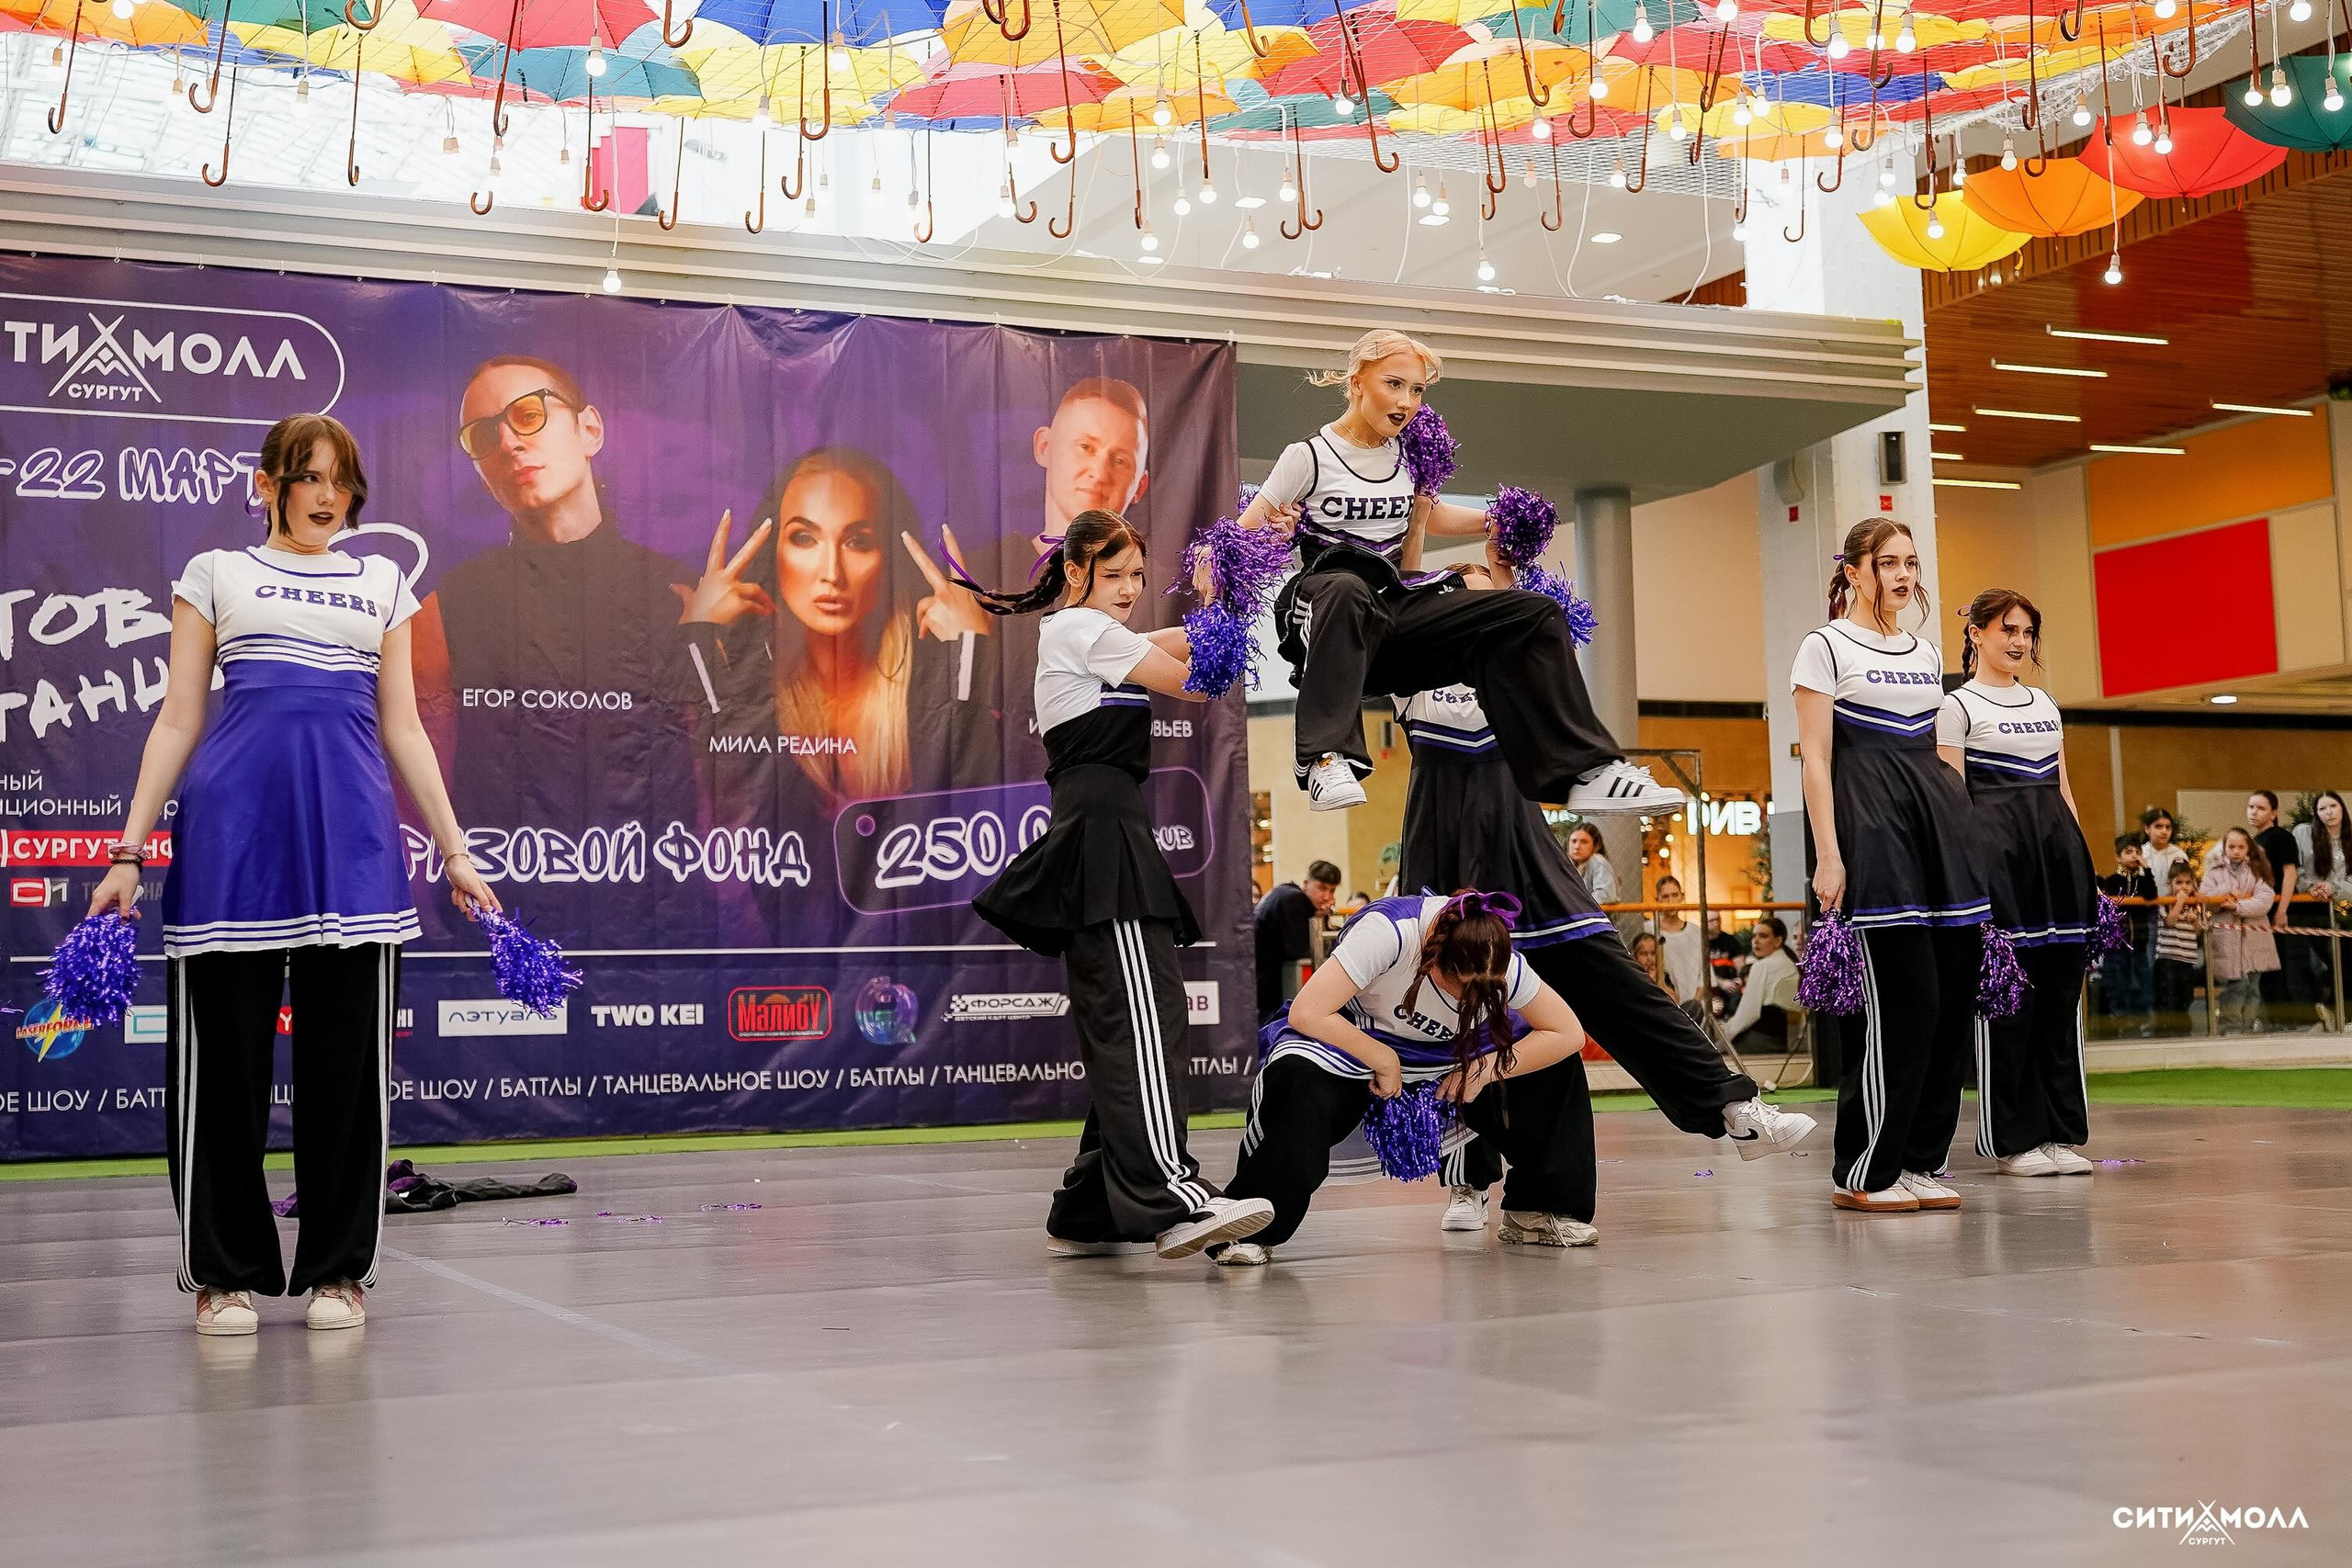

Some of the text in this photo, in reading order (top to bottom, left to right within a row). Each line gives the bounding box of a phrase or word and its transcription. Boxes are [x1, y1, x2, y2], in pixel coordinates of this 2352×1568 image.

[133, 329, 306, 380] МОЛЛ
[67, 382, 143, 402] СУРГУТ
[119, 446, 264, 507] МАРТ
[1319, 495, 1414, 520] CHEE
[255, 584, 378, 617] CHEERS
[463, 688, 633, 711] ЕГОР СОКОЛОВ
[1150, 719, 1193, 738] ВЬЕВ
[709, 735, 857, 756] МИЛА РЕДИНА
[0, 794, 121, 817] ционный
[399, 820, 810, 887] РЗОВОЙ ФОНД
[875, 805, 1053, 889] 250.0
[591, 1003, 704, 1027] TWO KEI
[971, 998, 1054, 1009] ФОРСАЖ
[1394, 1004, 1455, 1040] CHEE
[1189, 1055, 1238, 1076] ТТЛЫ
[421, 1078, 478, 1100] ШОУ
[501, 1076, 581, 1097] БАТТЛЫ
[603, 1070, 772, 1096] ТАНЦЕВАЛЬНОЕ
[777, 1069, 830, 1090] ШОУ
[850, 1066, 924, 1088] БАТТЛЫ
[944, 1060, 1087, 1085] ТАНЦЕВАЛЬНО
[28, 1089, 90, 1111] ШОУ
[116, 1088, 166, 1109] БАТТ
